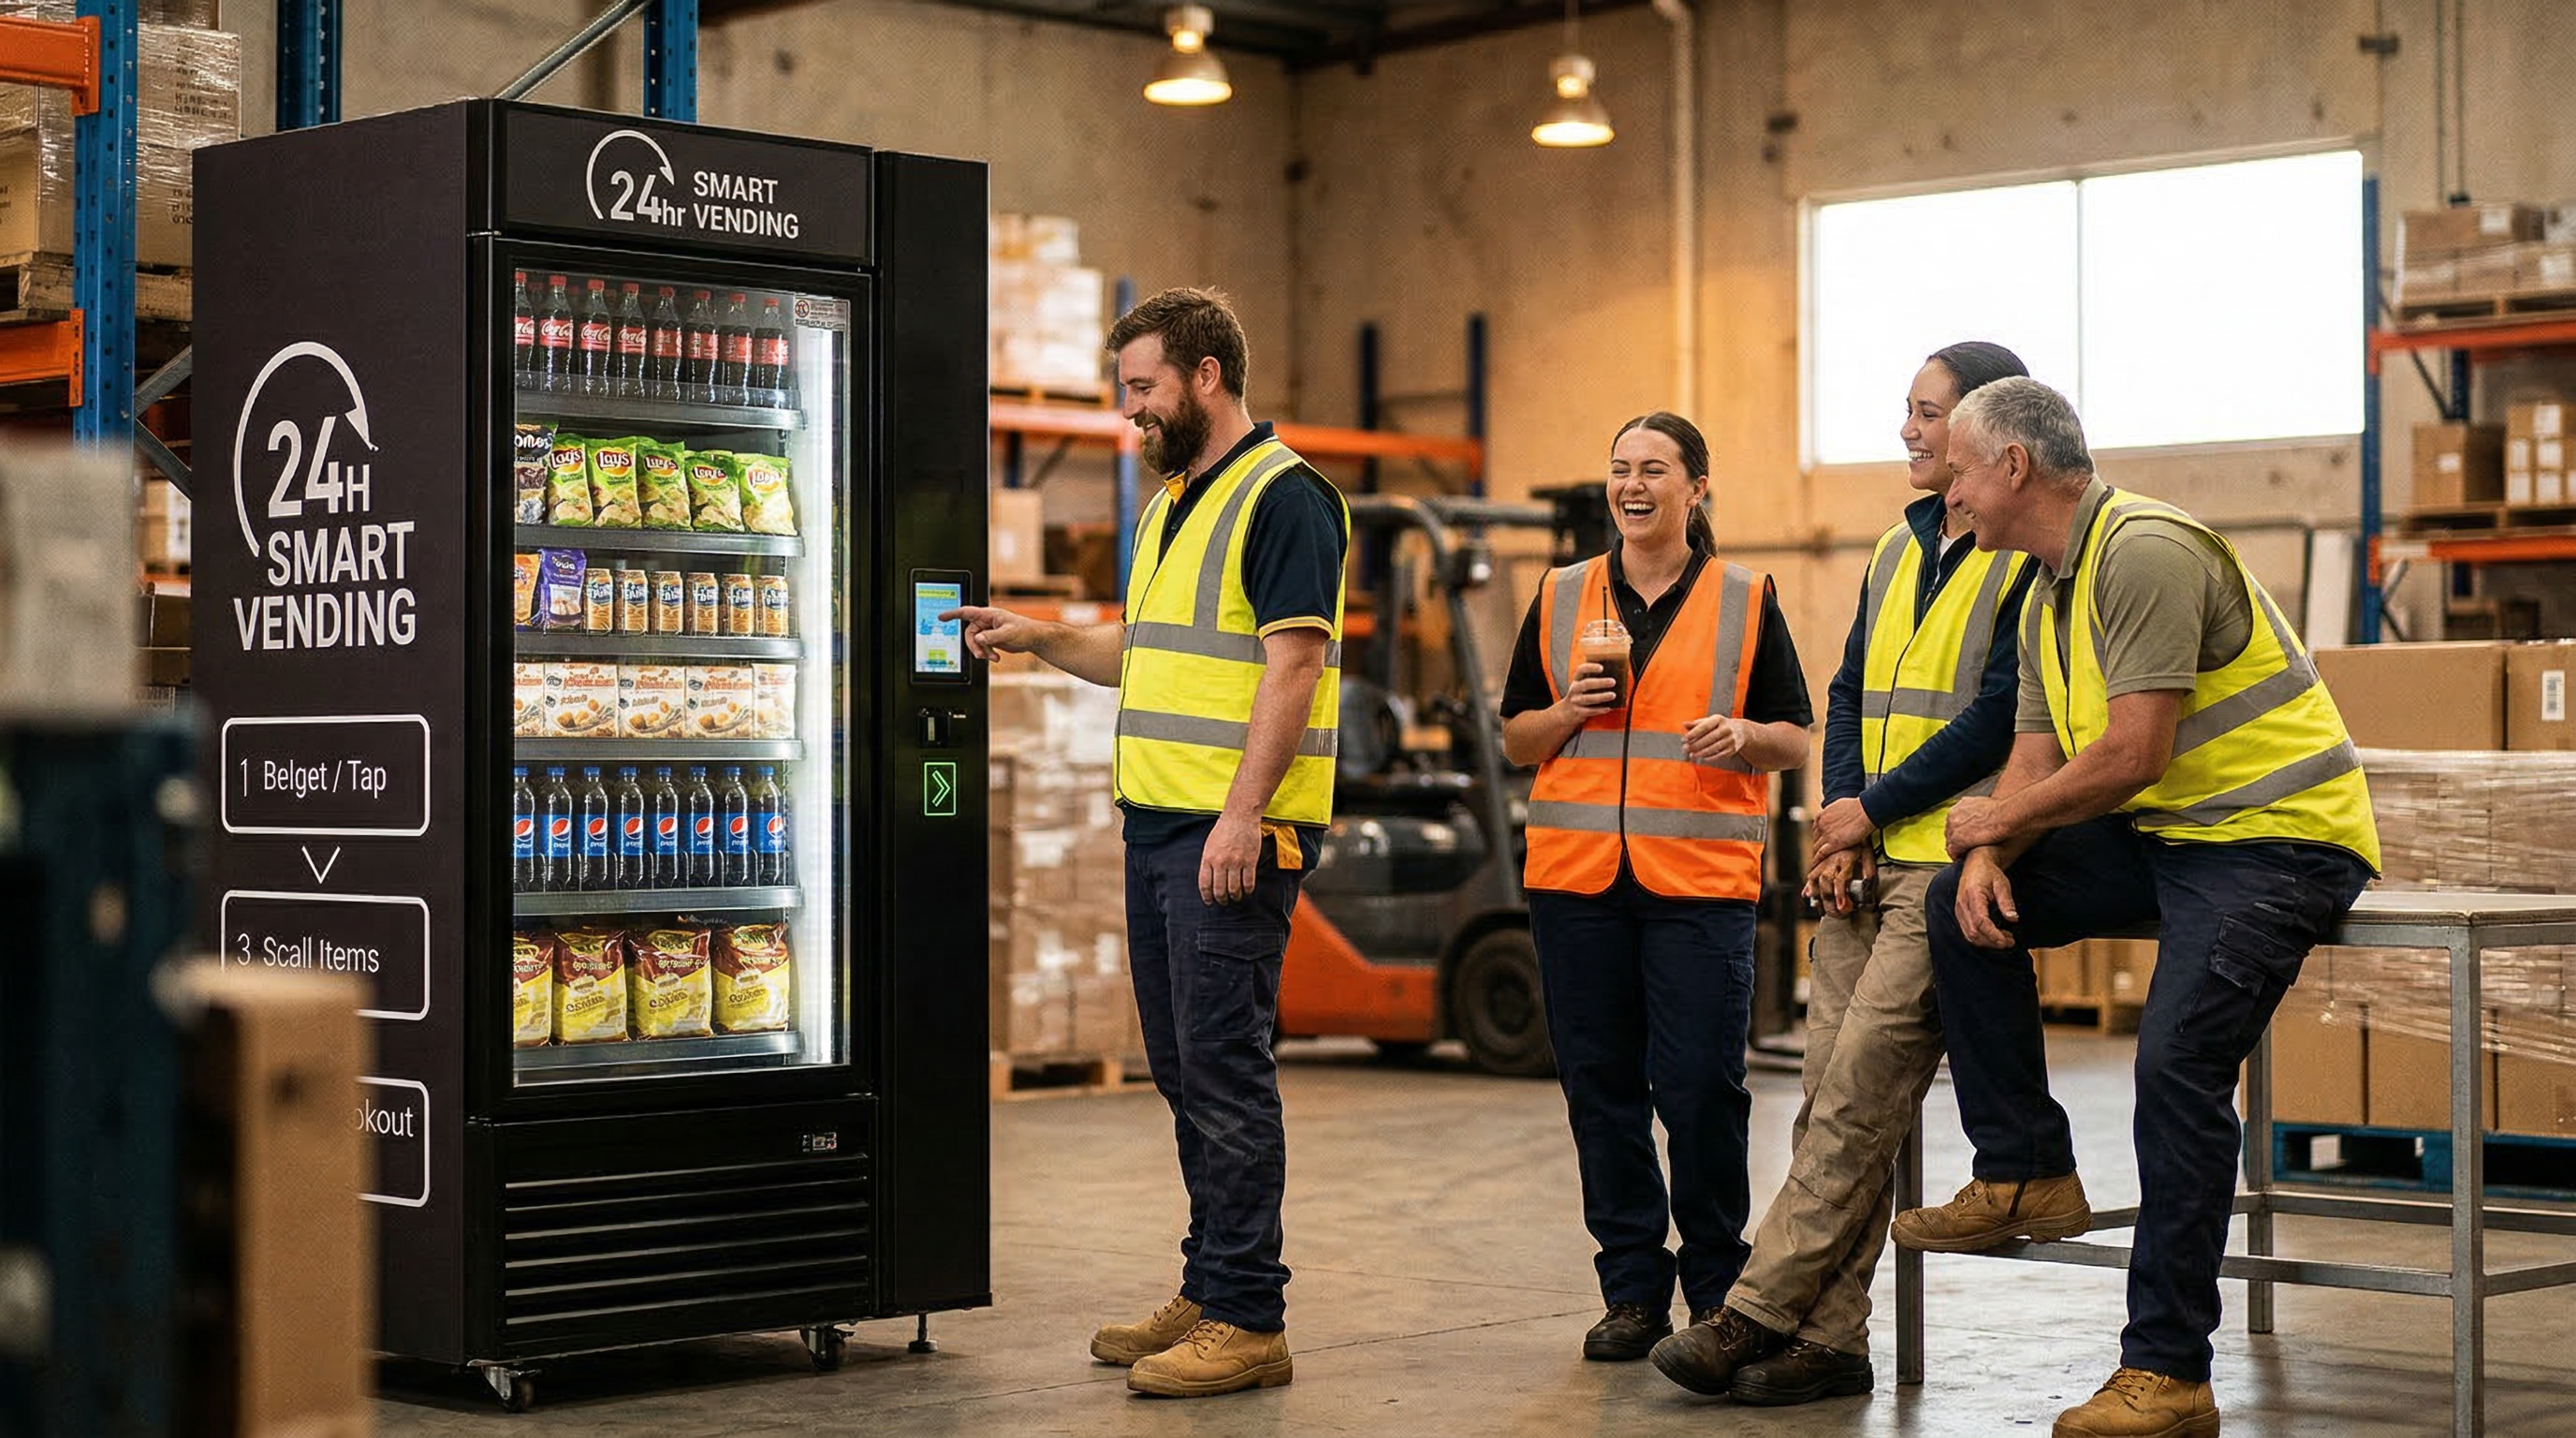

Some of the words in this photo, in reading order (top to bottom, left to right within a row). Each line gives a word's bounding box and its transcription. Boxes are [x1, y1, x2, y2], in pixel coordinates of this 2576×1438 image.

[610, 169, 687, 227] 24hr
[694, 170, 779, 204] SMART
[693, 202, 799, 240] VENDING
[267, 416, 370, 519] 24H
[268, 521, 415, 587] SMART
[233, 587, 416, 651] VENDING
[240, 758, 248, 798] 1
[264, 758, 328, 799] Belget
[331, 759, 343, 794] /
[346, 759, 387, 800] Tap
[237, 932, 251, 967] 3
[263, 936, 313, 969] Scall
[319, 939, 380, 974] Items
